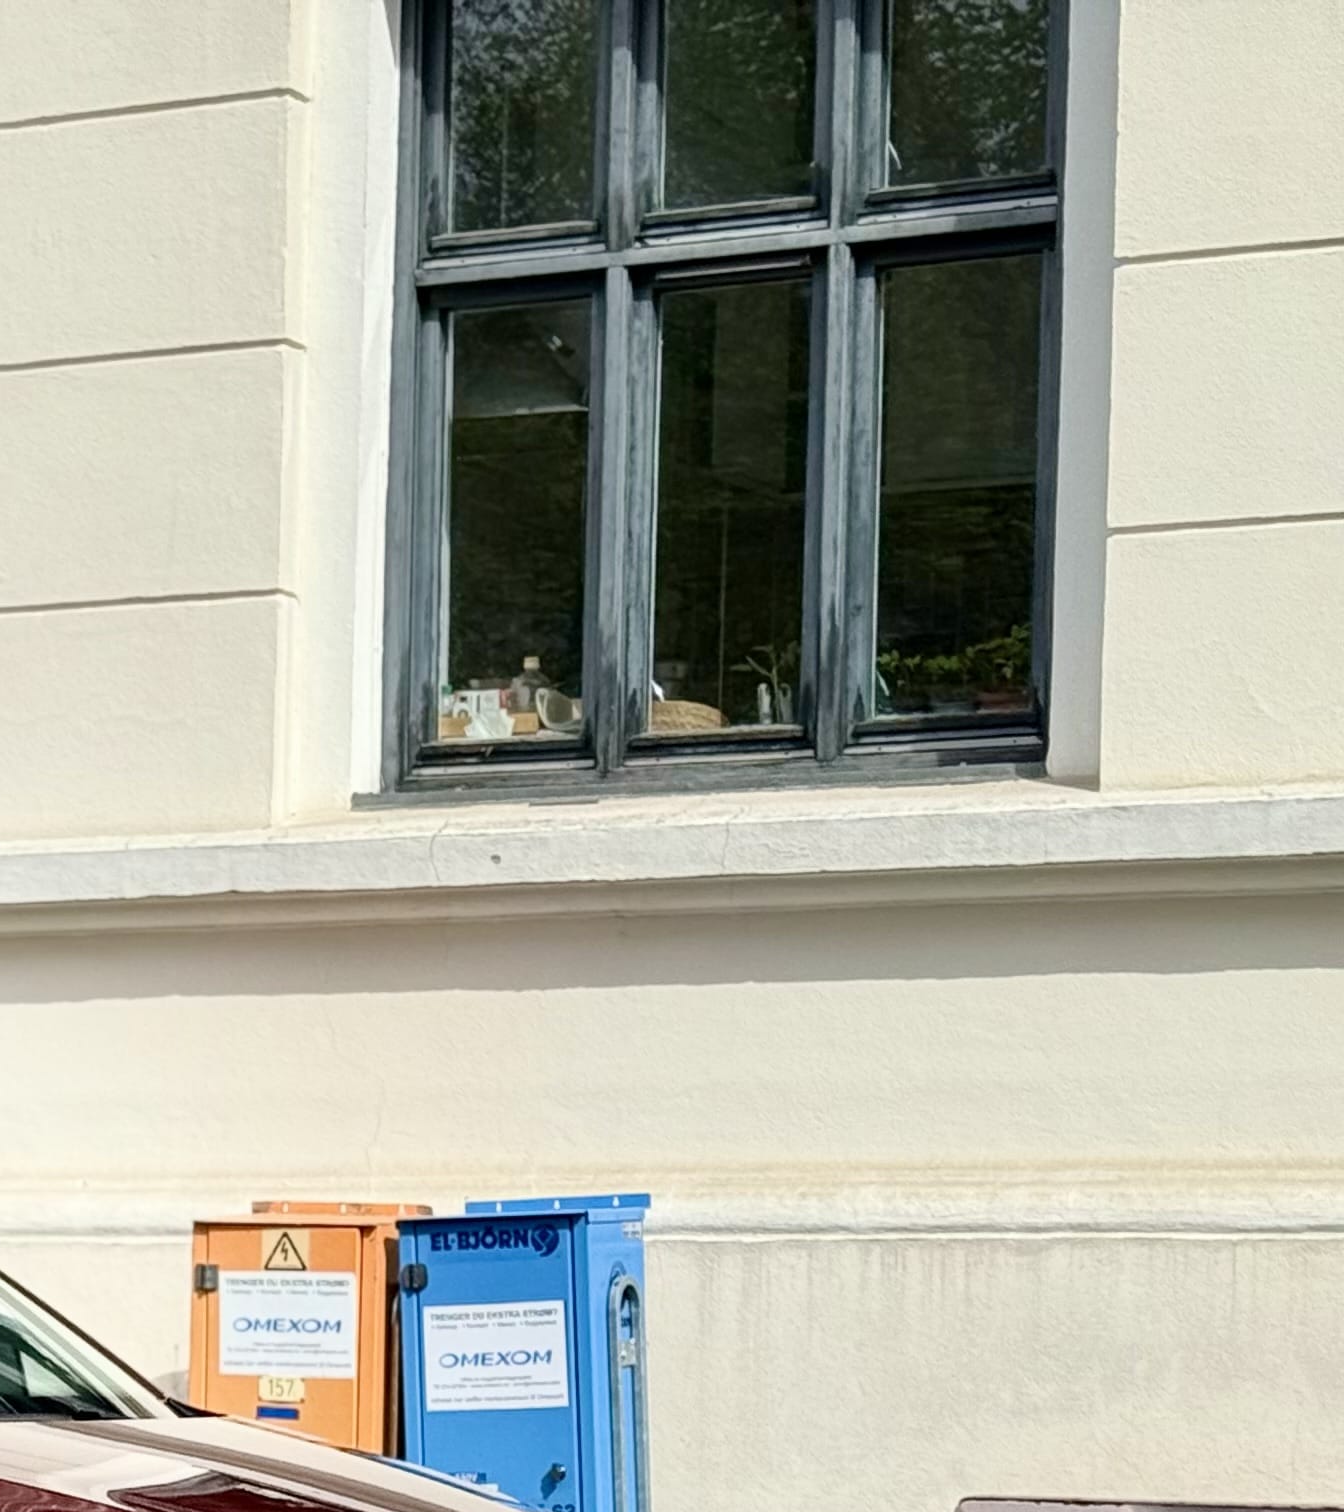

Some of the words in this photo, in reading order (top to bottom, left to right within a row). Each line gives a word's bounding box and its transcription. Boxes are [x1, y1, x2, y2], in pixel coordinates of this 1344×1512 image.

[233, 1317, 342, 1334] OMEXOM
[439, 1349, 553, 1369] OMEXOM
[268, 1377, 294, 1397] 157
